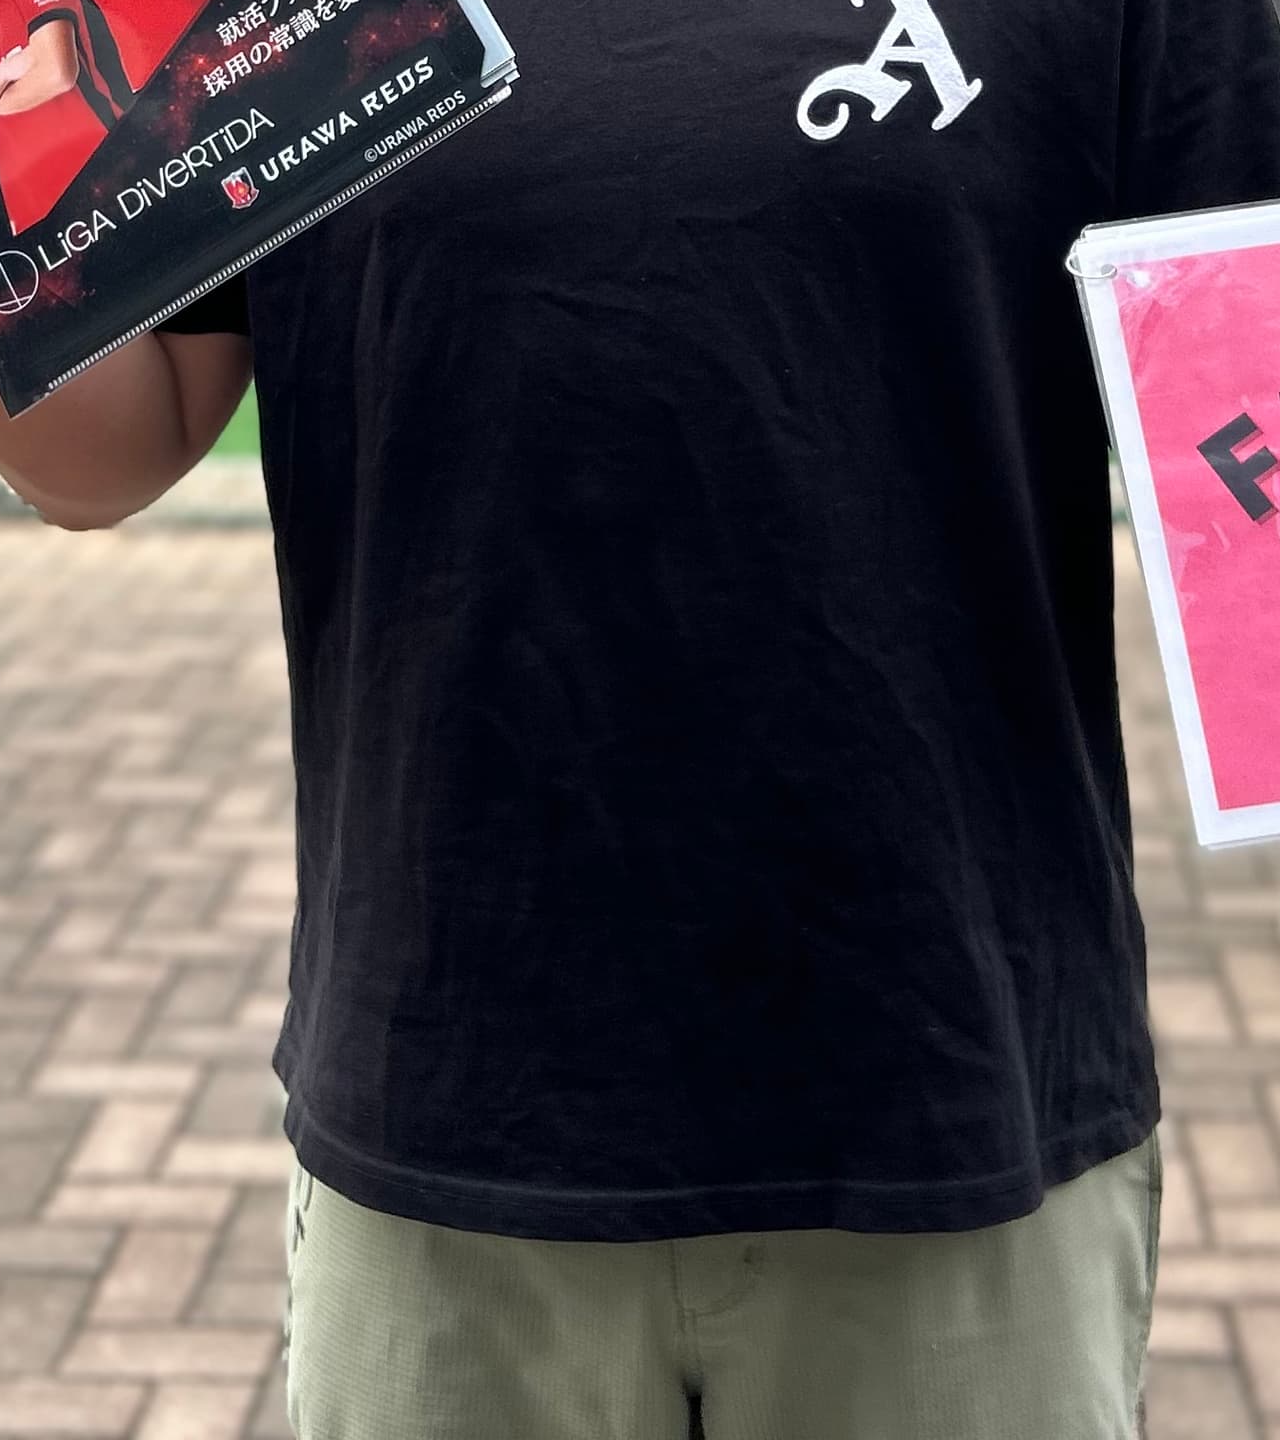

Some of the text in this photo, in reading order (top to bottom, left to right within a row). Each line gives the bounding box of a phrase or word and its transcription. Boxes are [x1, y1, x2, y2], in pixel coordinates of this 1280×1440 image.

[259, 56, 435, 182] URAWA REDS
[427, 89, 467, 122] REDS
